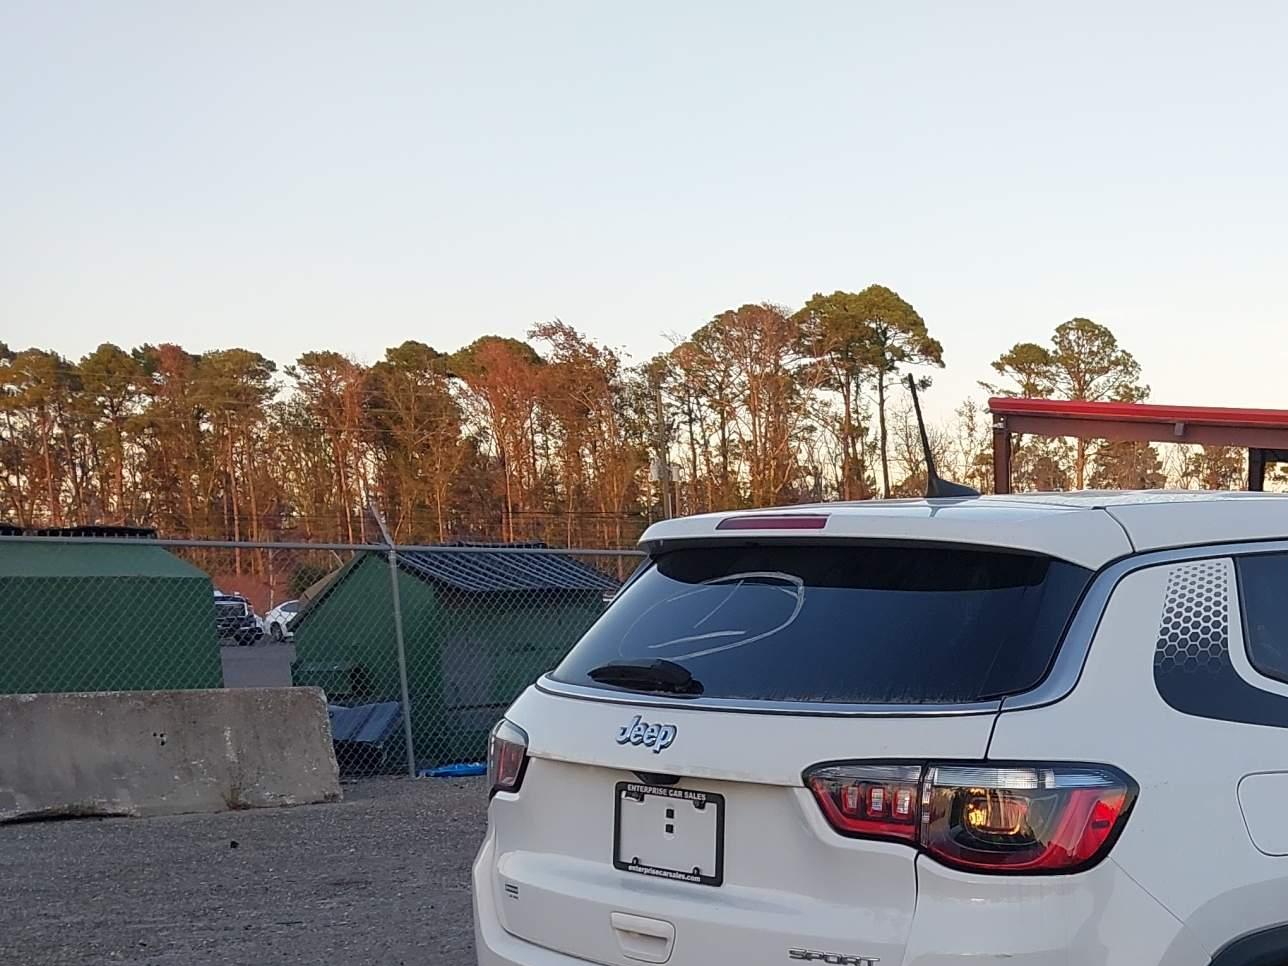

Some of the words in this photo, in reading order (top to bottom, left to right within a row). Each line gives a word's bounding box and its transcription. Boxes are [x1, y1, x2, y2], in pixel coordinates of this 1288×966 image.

[616, 715, 677, 754] Jeep
[627, 784, 668, 796] ENTERPRISE
[668, 789, 683, 798] CAR
[684, 791, 706, 801] SALES
[628, 865, 701, 882] enterprisecarsales.com
